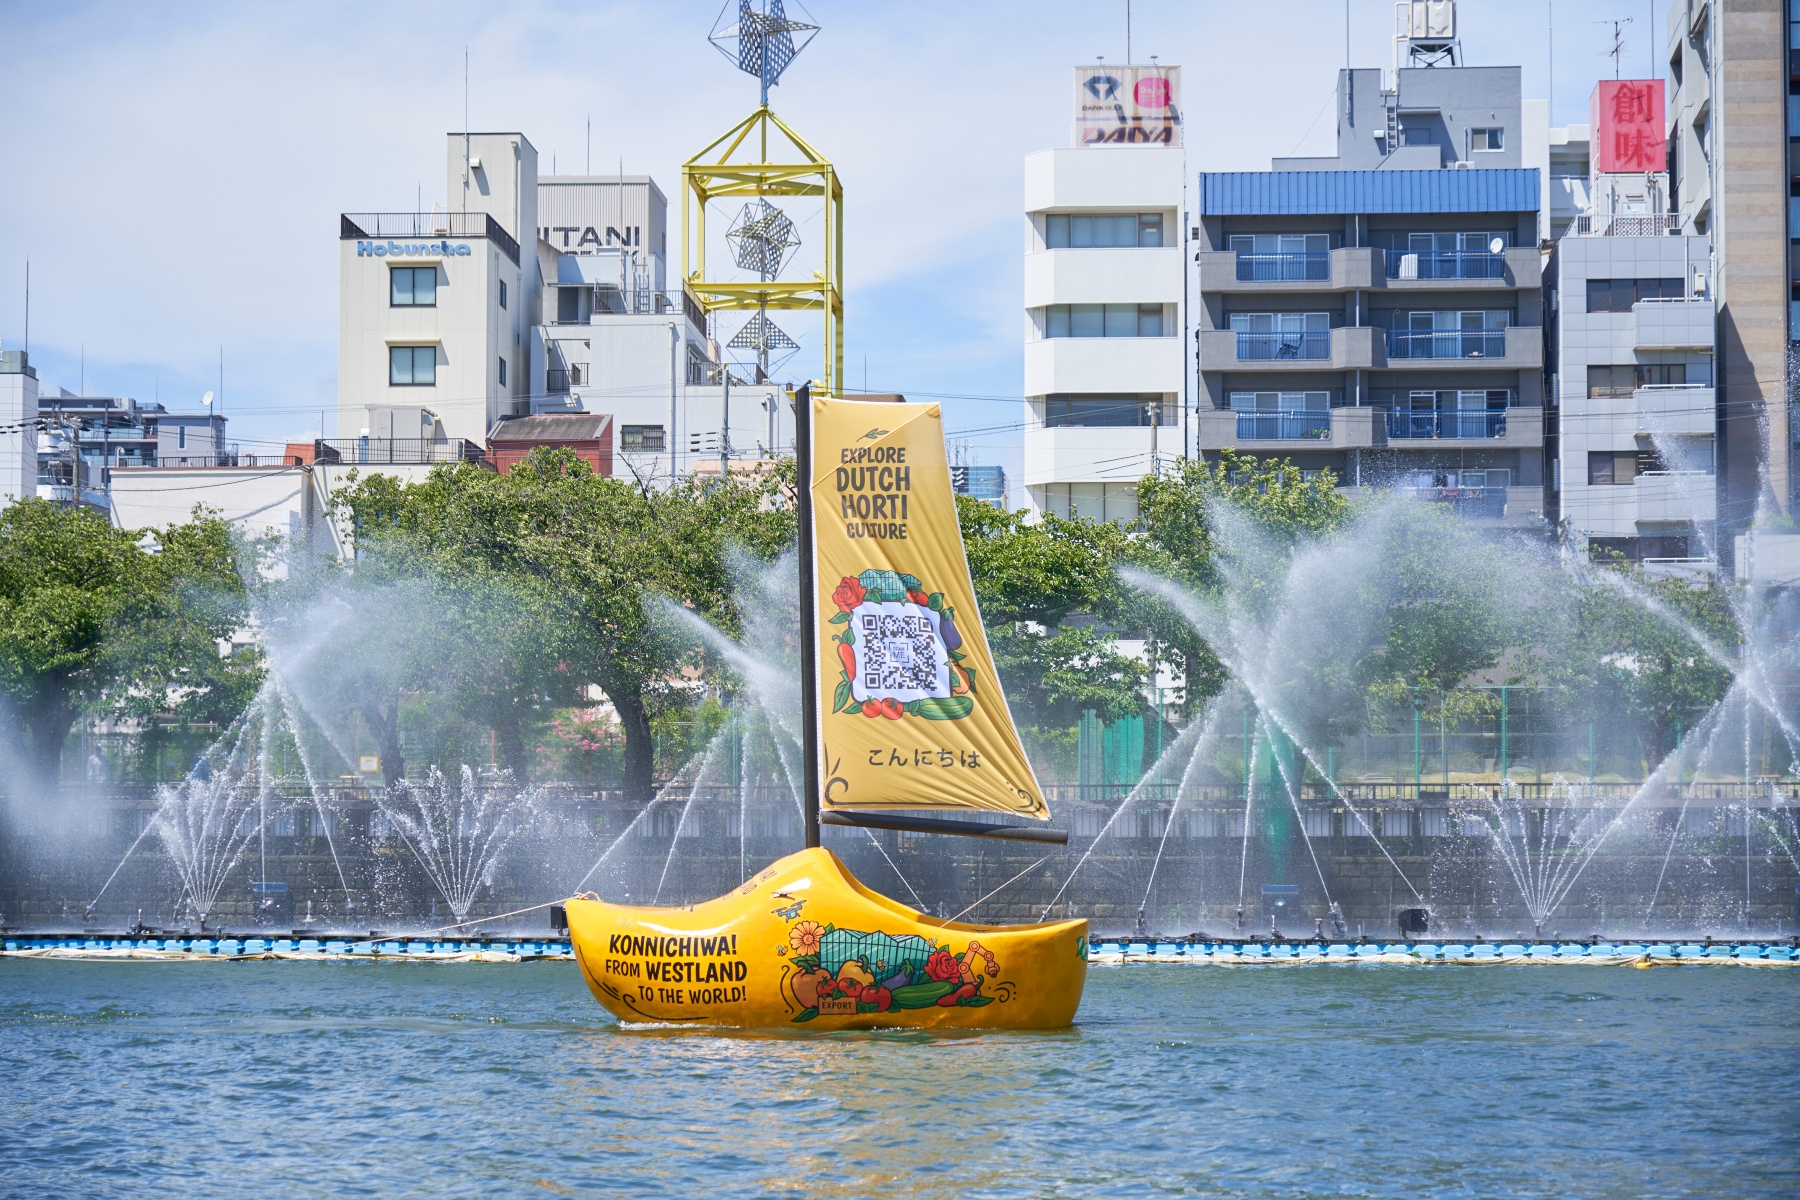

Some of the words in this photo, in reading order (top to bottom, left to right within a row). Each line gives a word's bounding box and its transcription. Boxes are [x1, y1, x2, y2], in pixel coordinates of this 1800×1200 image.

[1083, 127, 1173, 144] DAIYA
[1611, 83, 1656, 168] 創味
[537, 226, 640, 247] ITANI
[357, 241, 472, 257] Hobunsha
[841, 447, 906, 464] EXPLORE
[836, 466, 911, 492] DUTCH
[841, 494, 908, 520] HORTI
[846, 522, 908, 540] CULTURE
[868, 748, 982, 769] こんにちは
[609, 934, 737, 958] KONNICHIWA!
[605, 959, 641, 978] FROM
[645, 960, 748, 984] WESTLAND
[638, 985, 654, 1002] TO
[658, 988, 684, 1005] THE
[689, 985, 747, 1005] WORLD!
[822, 1001, 853, 1010] EXPORT
